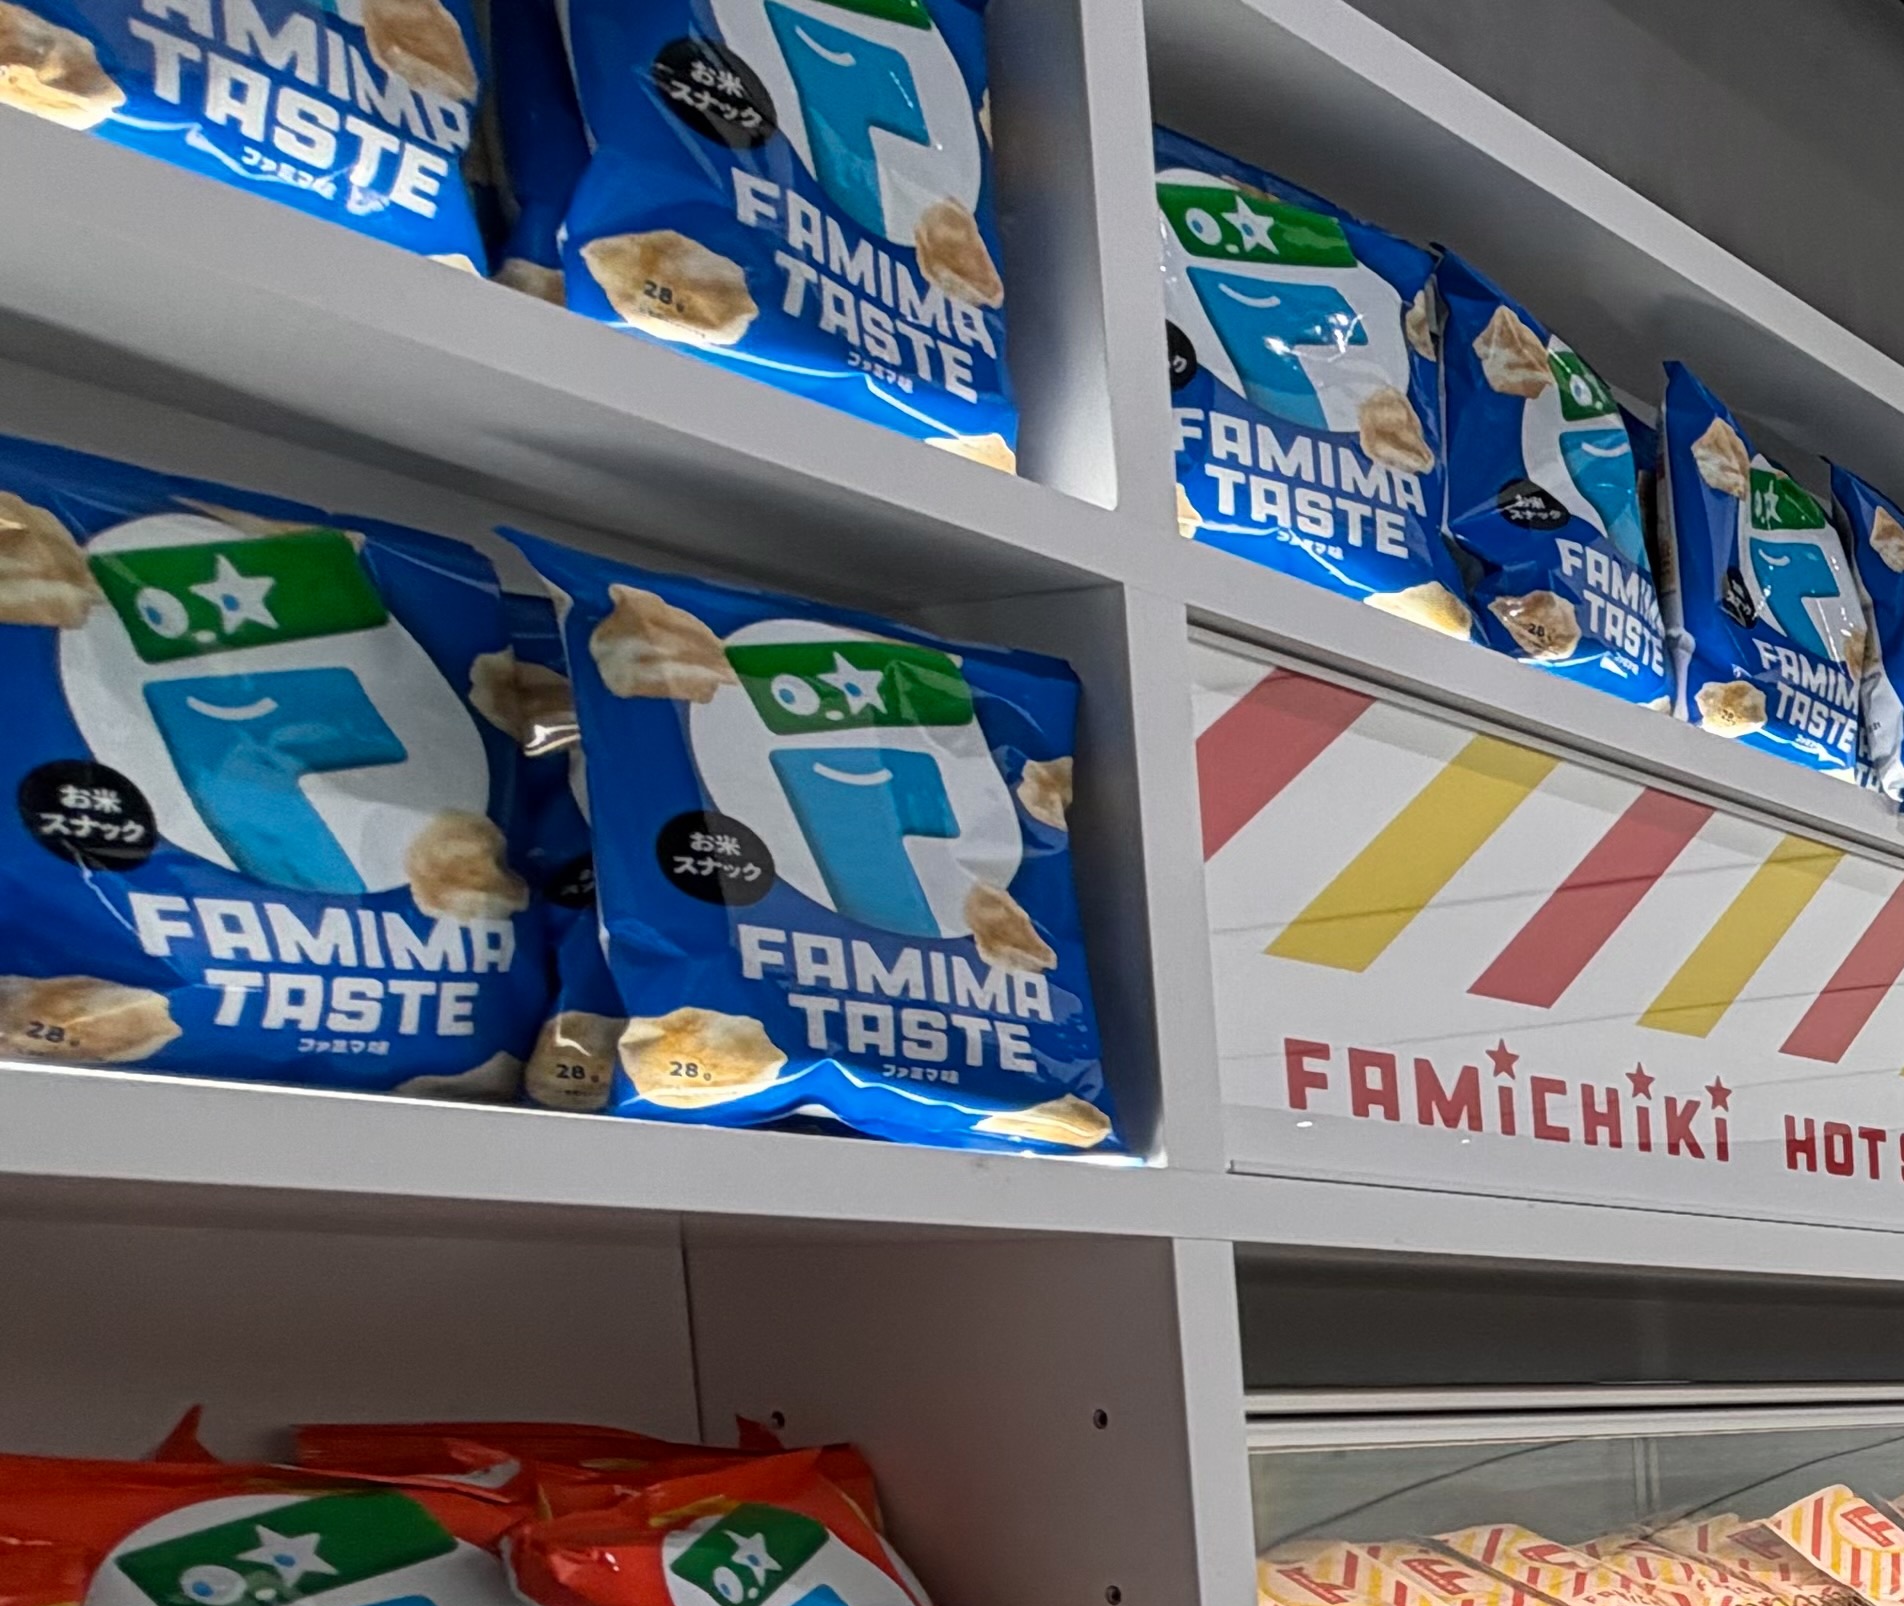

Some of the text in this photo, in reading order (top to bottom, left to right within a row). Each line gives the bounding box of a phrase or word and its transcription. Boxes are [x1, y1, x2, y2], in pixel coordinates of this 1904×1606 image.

[670, 77, 762, 131] スナック
[688, 58, 746, 101] お米
[128, 18, 449, 219] TASTE
[731, 166, 996, 357] FAMIMA
[776, 250, 978, 404] TASTE
[1172, 408, 1429, 517] FAMIMA
[1204, 465, 1410, 560] TASTE
[1583, 588, 1666, 676] TASTE
[1774, 680, 1859, 754] TASTE
[37, 812, 147, 847] スナック
[58, 784, 123, 818] お米
[672, 852, 763, 884] スナック
[688, 830, 742, 859] お米
[127, 890, 516, 975] FAMIMA
[202, 968, 474, 1038] TASTE
[738, 922, 1053, 1021] FAMIMA
[786, 993, 1039, 1074] TASTE
[1783, 1112, 1887, 1181] HOT
